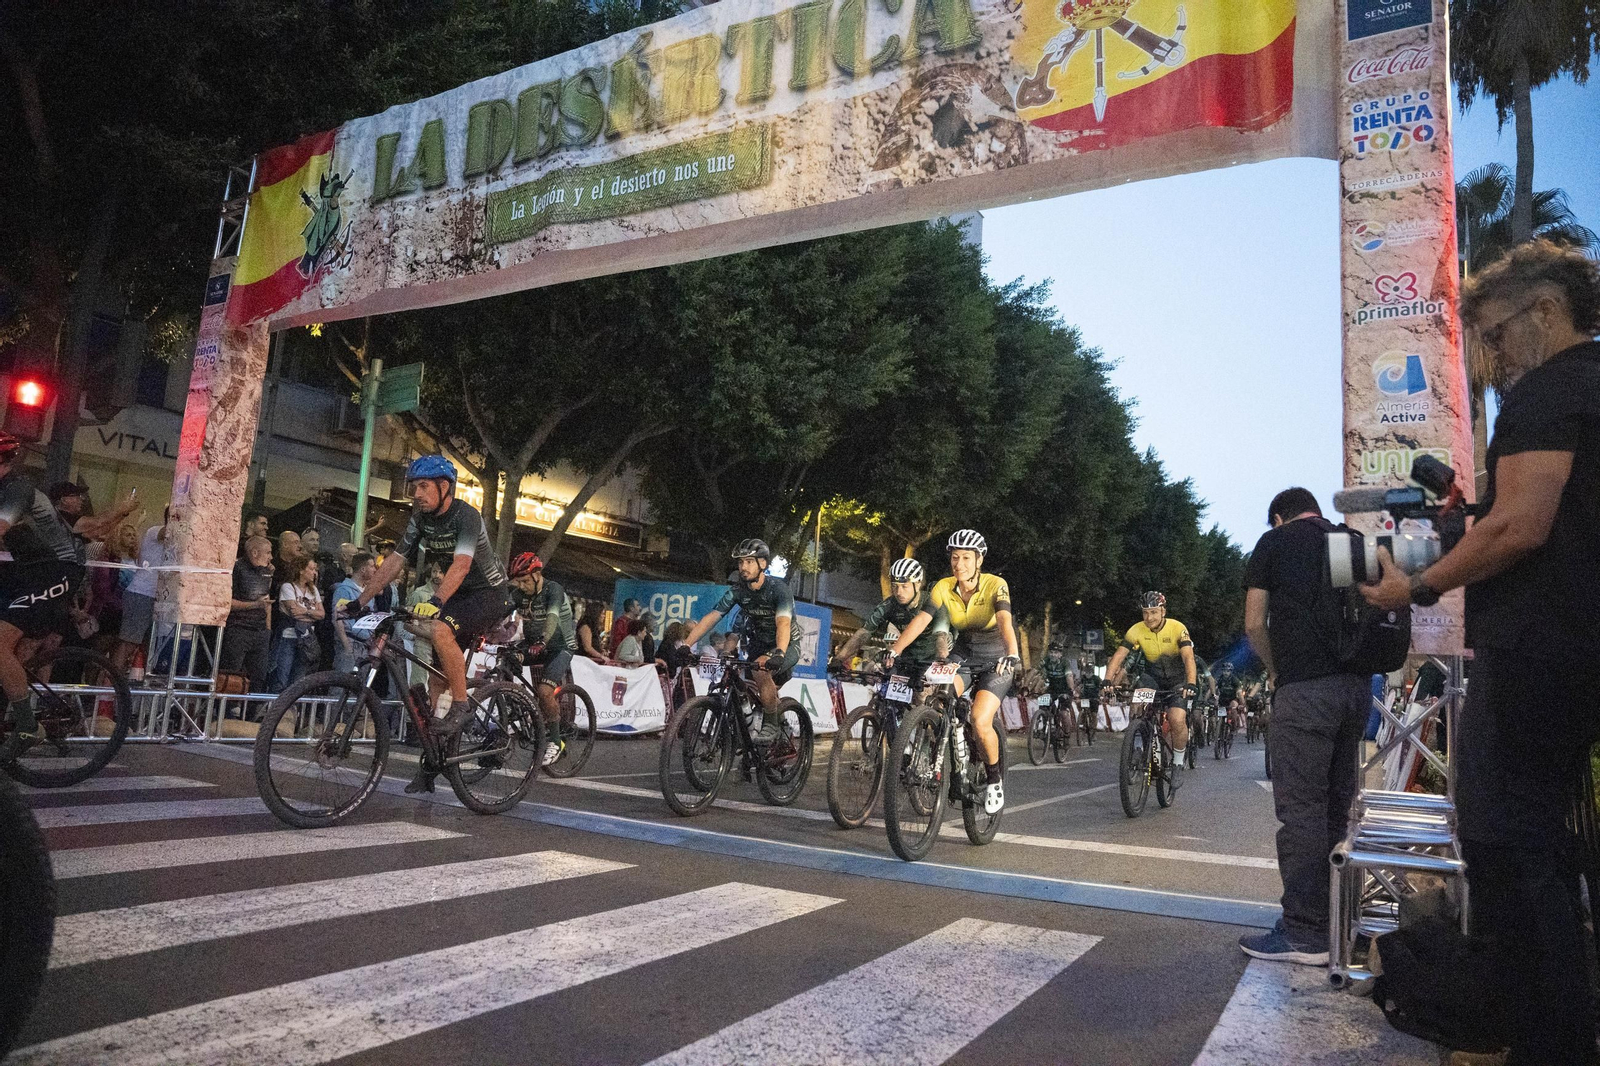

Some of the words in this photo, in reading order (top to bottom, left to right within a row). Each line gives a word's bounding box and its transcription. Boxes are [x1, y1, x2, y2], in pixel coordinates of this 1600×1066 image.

[1364, 2, 1412, 19] SENATOR
[1353, 91, 1430, 113] GRUPO
[1353, 104, 1434, 132] RENTA
[1353, 124, 1434, 153] TODO
[373, 118, 447, 199] LA
[511, 200, 525, 220] La
[531, 185, 565, 215] Legión
[573, 186, 584, 207] y
[591, 179, 604, 200] el
[611, 169, 666, 196] desierto
[674, 161, 699, 182] nos
[707, 154, 736, 174] une
[1357, 301, 1444, 325] primaflor
[1376, 400, 1430, 412] Almería
[1380, 412, 1426, 423] Activa
